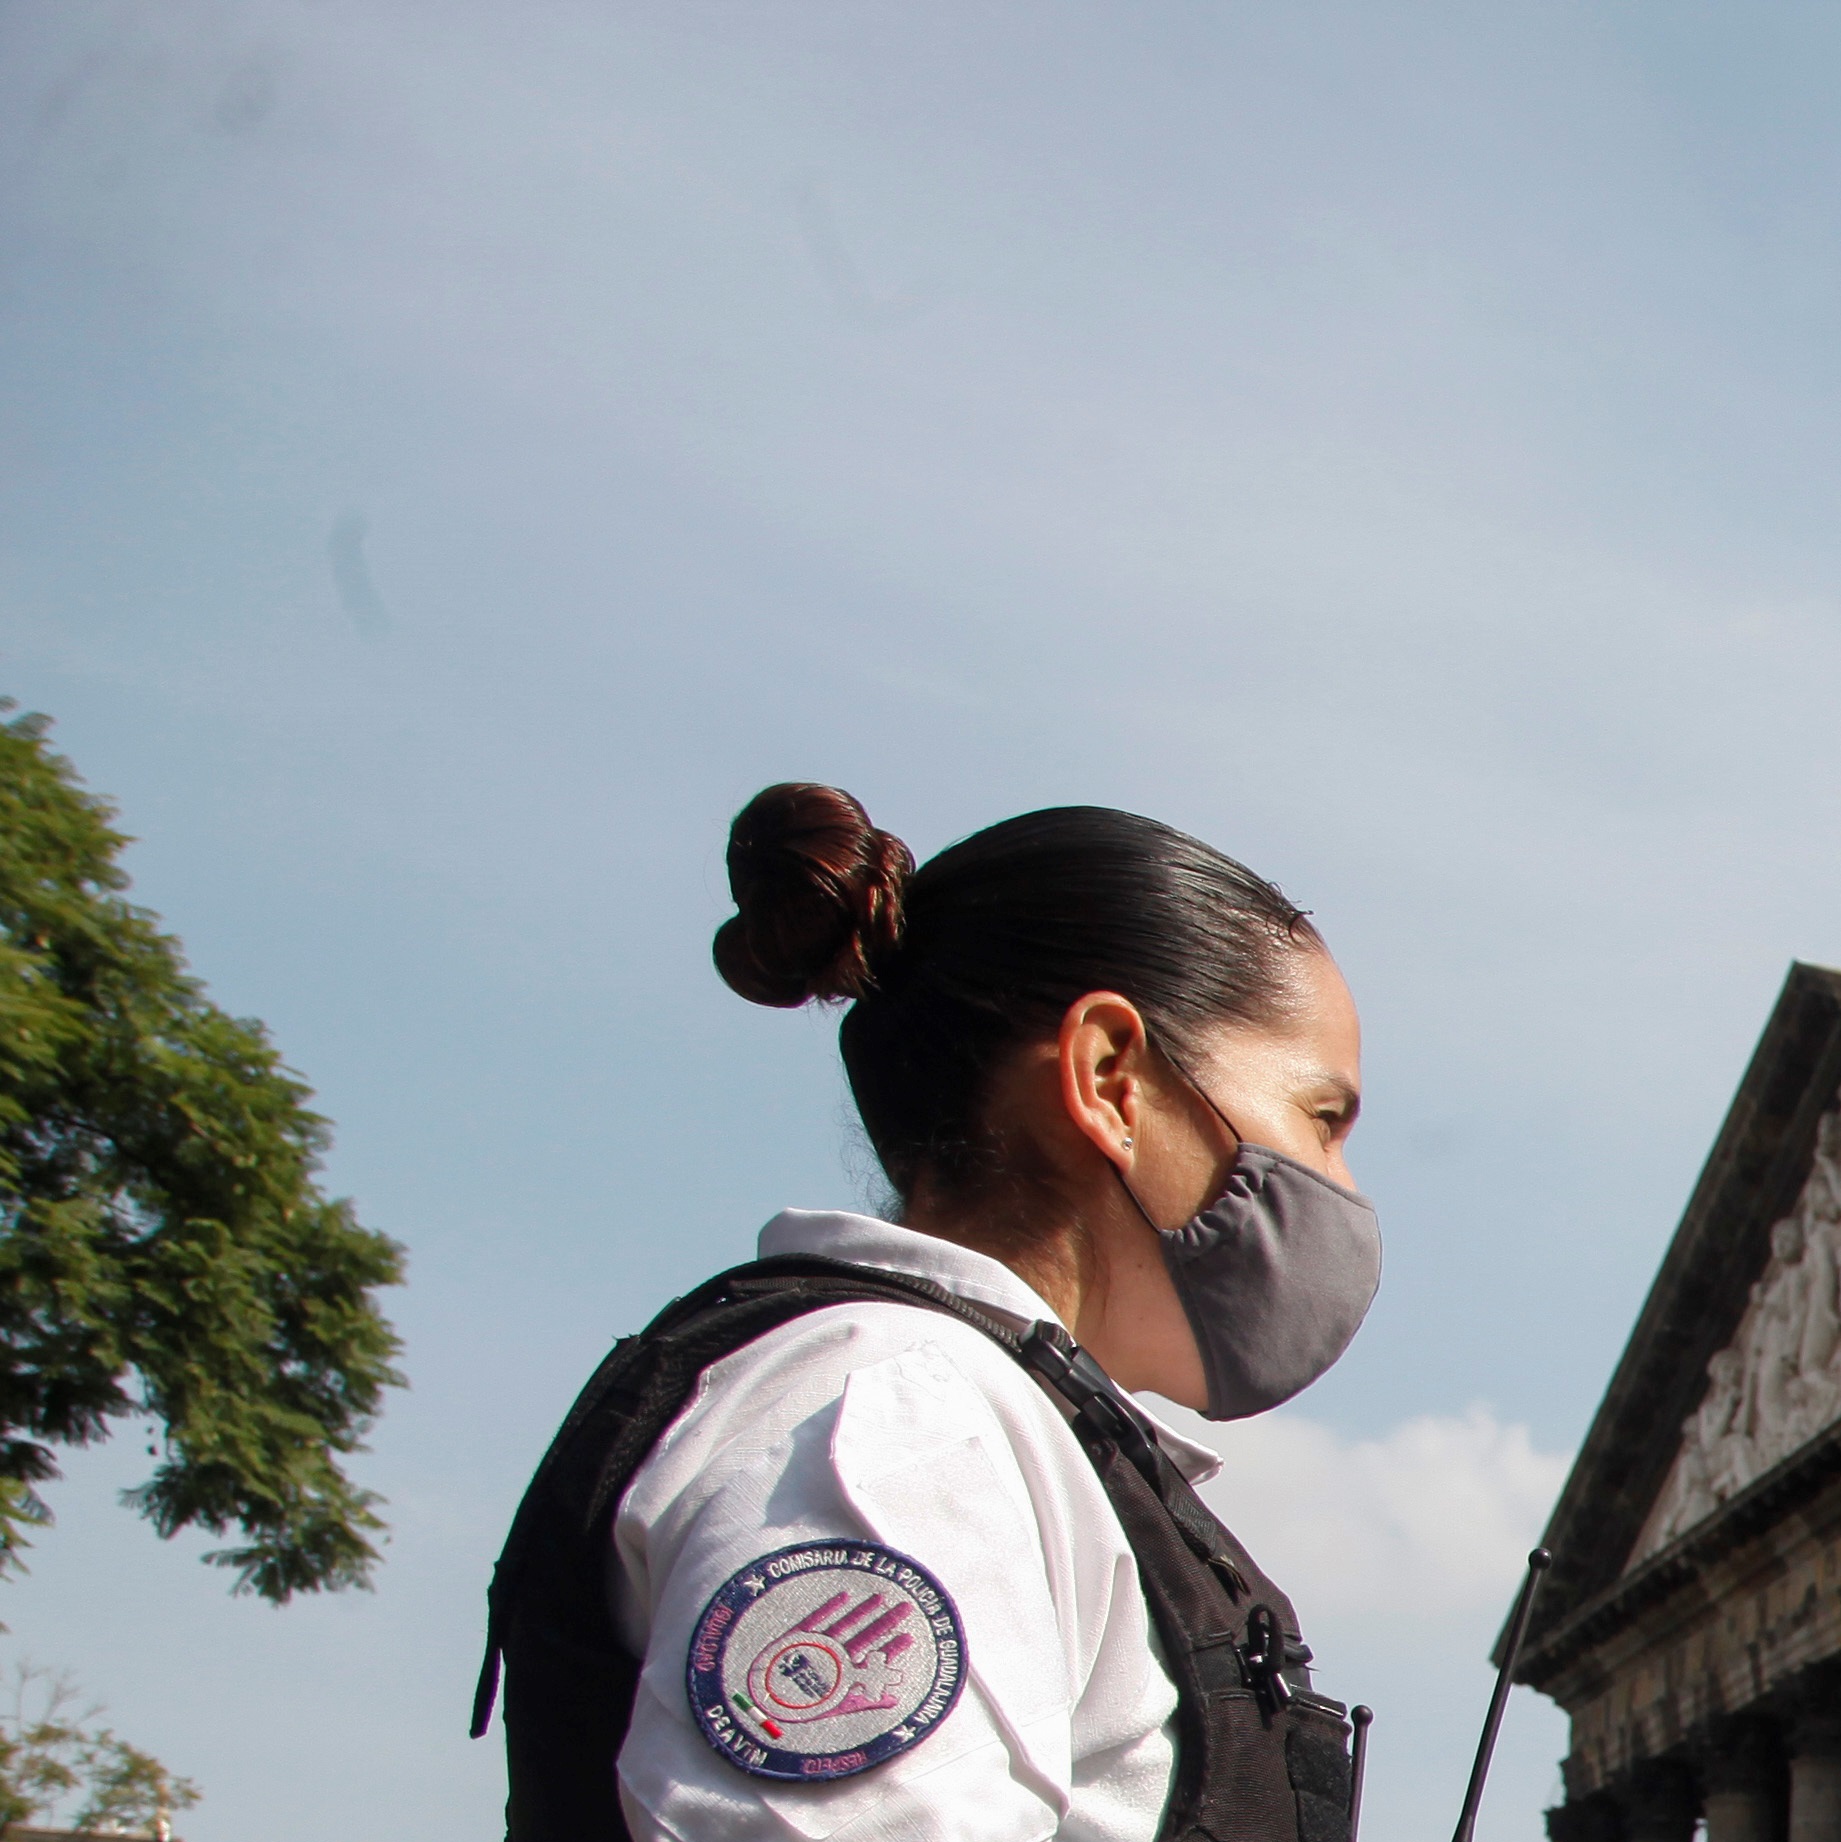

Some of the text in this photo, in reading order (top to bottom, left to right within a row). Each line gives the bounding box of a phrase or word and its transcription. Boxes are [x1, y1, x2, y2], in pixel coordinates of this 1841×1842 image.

[851, 1551, 875, 1568] DE
[876, 1556, 897, 1577] LA
[932, 1616, 954, 1636] DE
